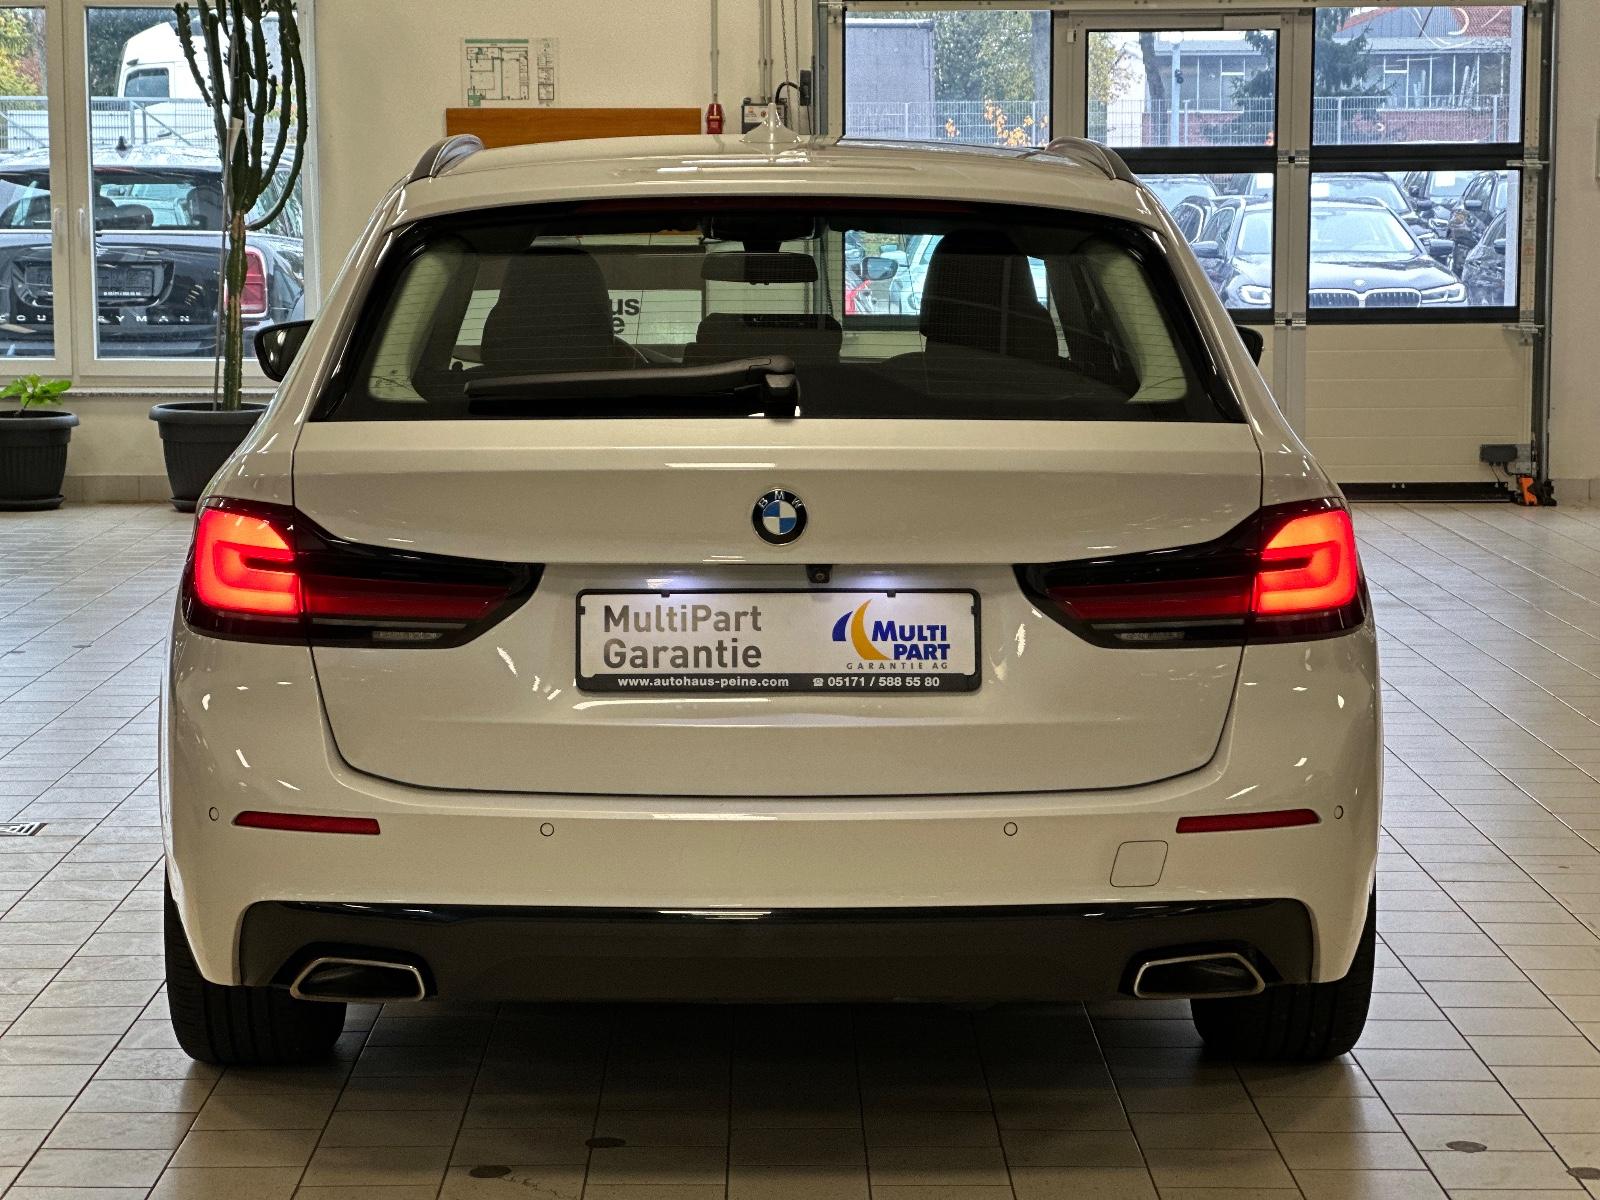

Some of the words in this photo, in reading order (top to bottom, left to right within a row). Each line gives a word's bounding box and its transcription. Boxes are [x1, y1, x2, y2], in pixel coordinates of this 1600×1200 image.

[0, 314, 190, 322] COURYMAN
[758, 490, 803, 510] BMW
[603, 604, 762, 632] MultiPart
[871, 620, 947, 642] MULTI
[603, 638, 762, 669] Garantie
[893, 643, 951, 661] PART
[846, 662, 924, 670] GARANTIE
[932, 662, 948, 670] AG
[618, 676, 790, 689] www.autohaus-peine.com
[827, 676, 865, 687] 05171
[878, 676, 902, 687] 588
[905, 676, 921, 687] 55
[924, 676, 940, 687] 80
